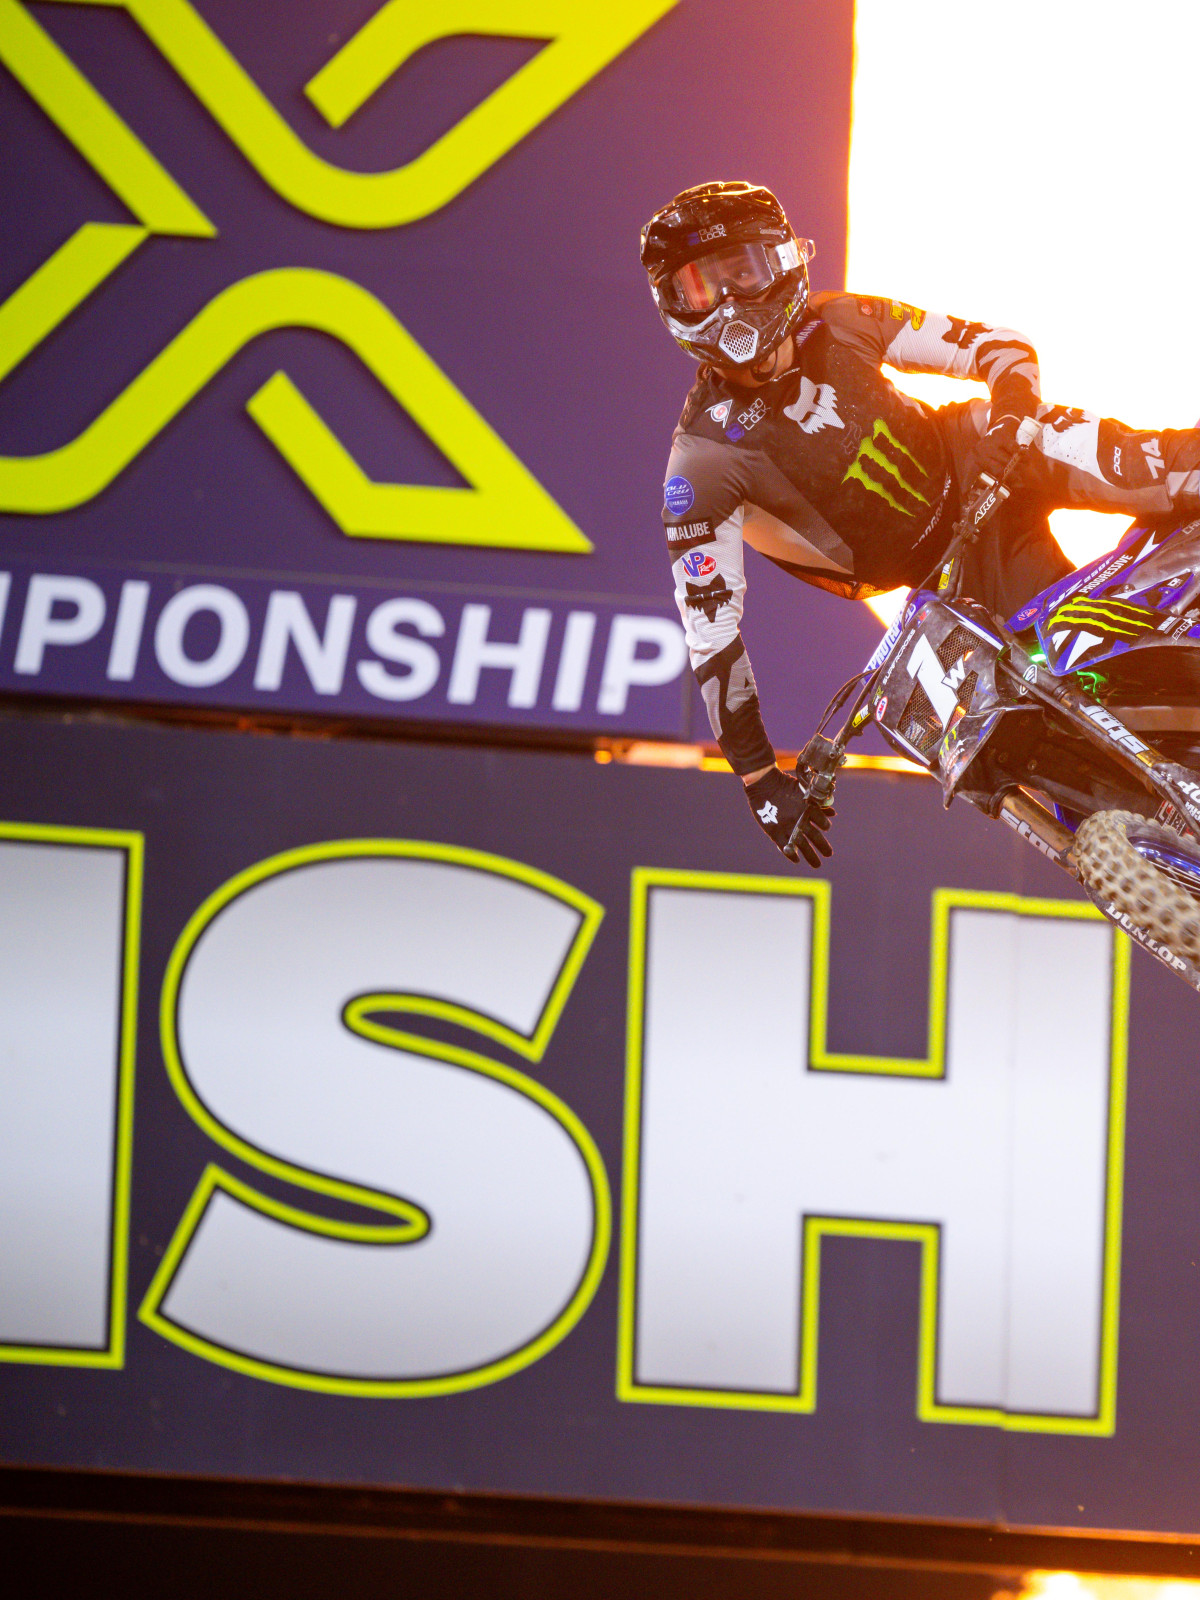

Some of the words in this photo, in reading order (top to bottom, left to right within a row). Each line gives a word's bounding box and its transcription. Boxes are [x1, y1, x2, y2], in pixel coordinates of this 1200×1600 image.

[701, 230, 727, 243] LOCK
[737, 397, 765, 425] QUAD
[744, 406, 771, 431] LOCK
[974, 492, 997, 525] ARC
[1078, 554, 1134, 594] PROGRESSIVE
[0, 572, 688, 716] PIONSHIP
[882, 628, 916, 685] SUPERCROSS
[906, 633, 959, 733] 1
[1105, 902, 1187, 971] DUNLOP
